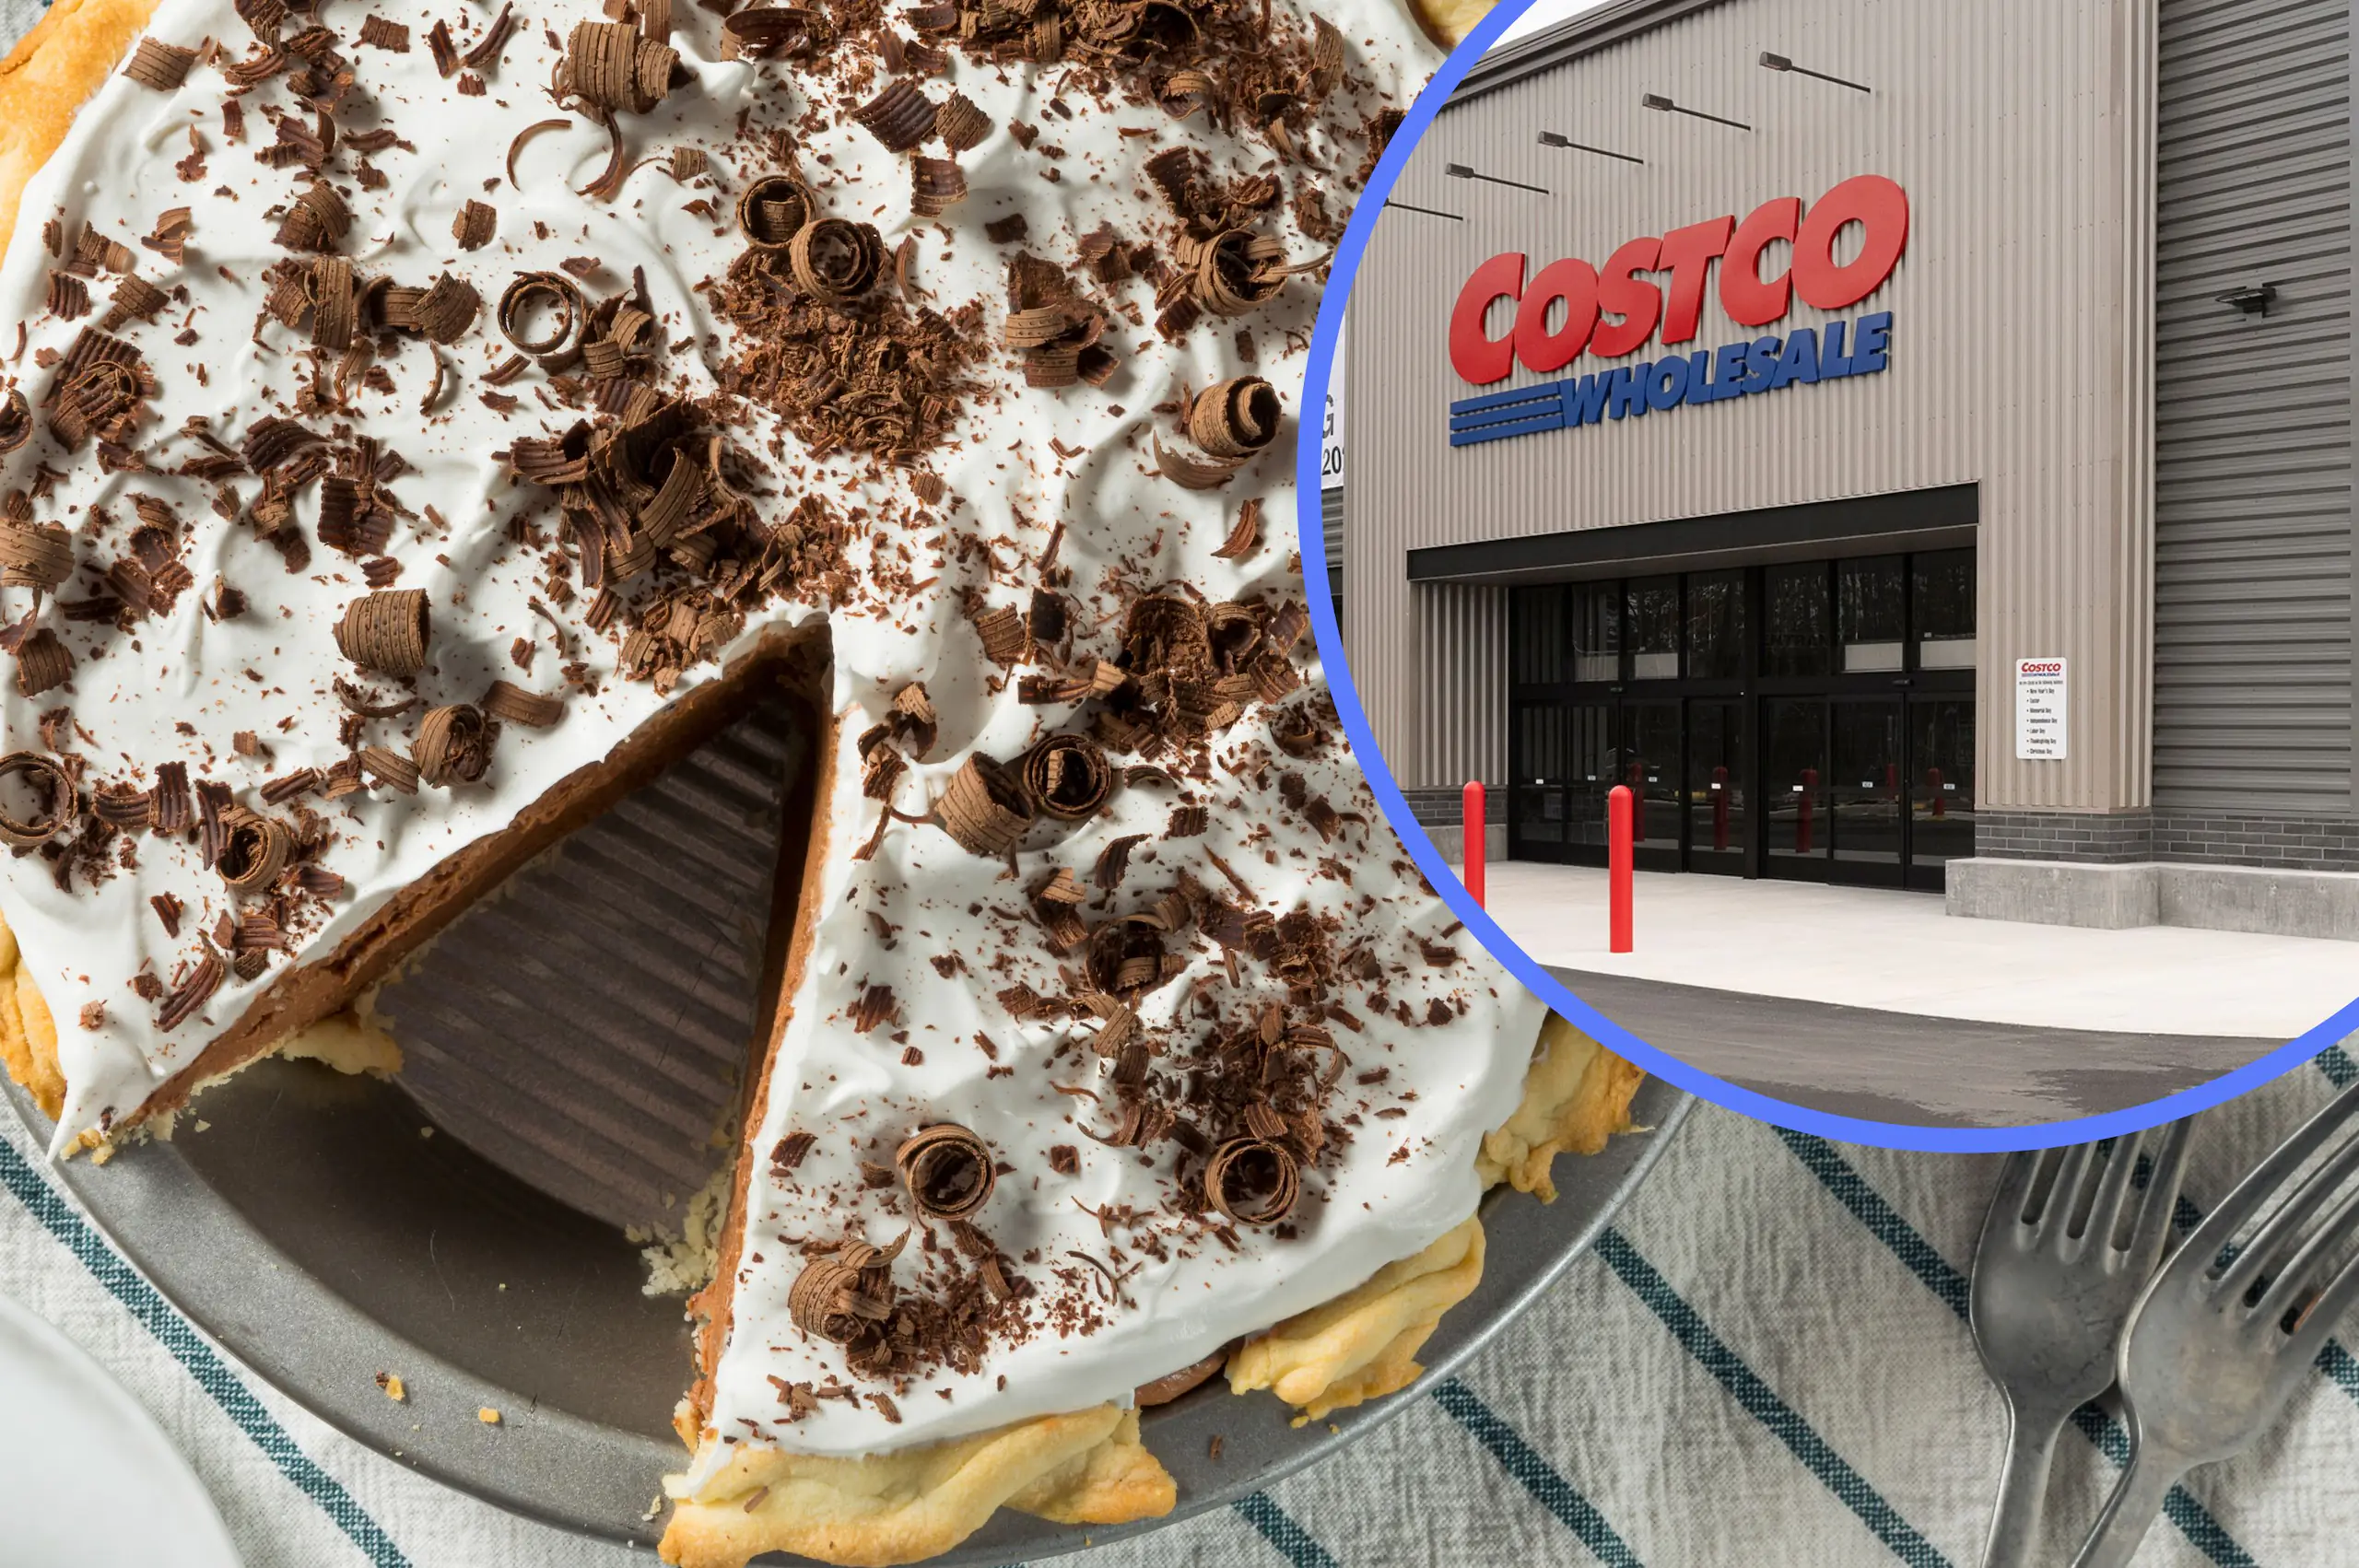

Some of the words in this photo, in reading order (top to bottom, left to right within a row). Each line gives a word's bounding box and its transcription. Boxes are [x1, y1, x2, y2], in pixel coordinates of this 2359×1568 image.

[1449, 174, 1909, 385] COSTCO
[1559, 310, 1893, 427] WHOLESALE
[1321, 446, 1344, 475] 20
[2022, 661, 2061, 673] COSTCO
